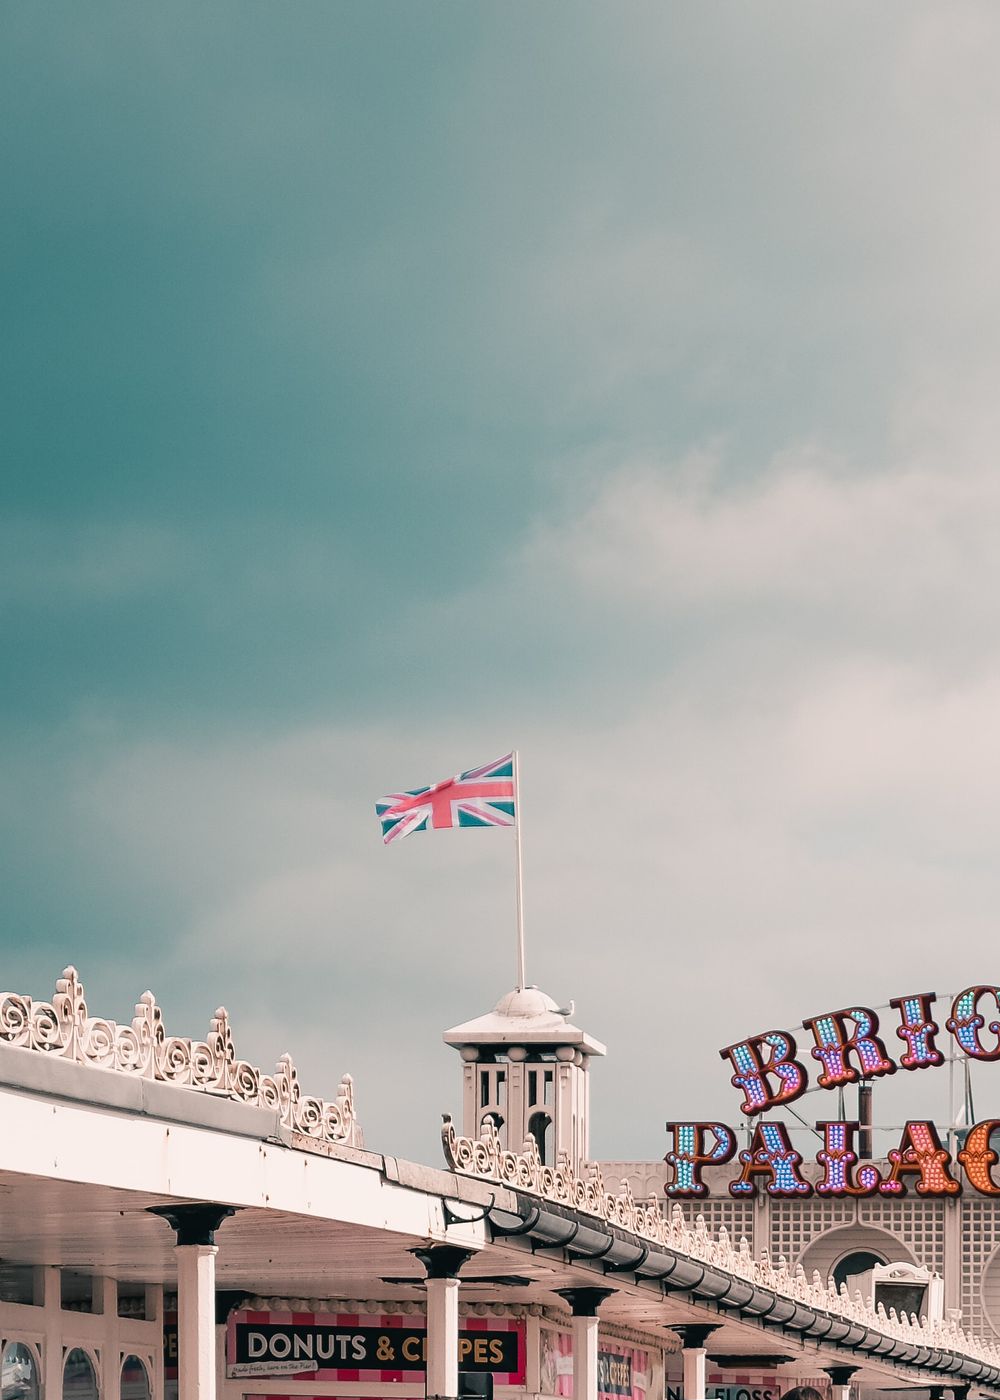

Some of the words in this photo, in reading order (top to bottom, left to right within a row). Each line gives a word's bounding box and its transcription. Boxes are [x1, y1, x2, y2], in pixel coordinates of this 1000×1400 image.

[248, 1332, 366, 1360] DONUTS
[376, 1335, 395, 1361] &
[402, 1336, 503, 1364] CPES
